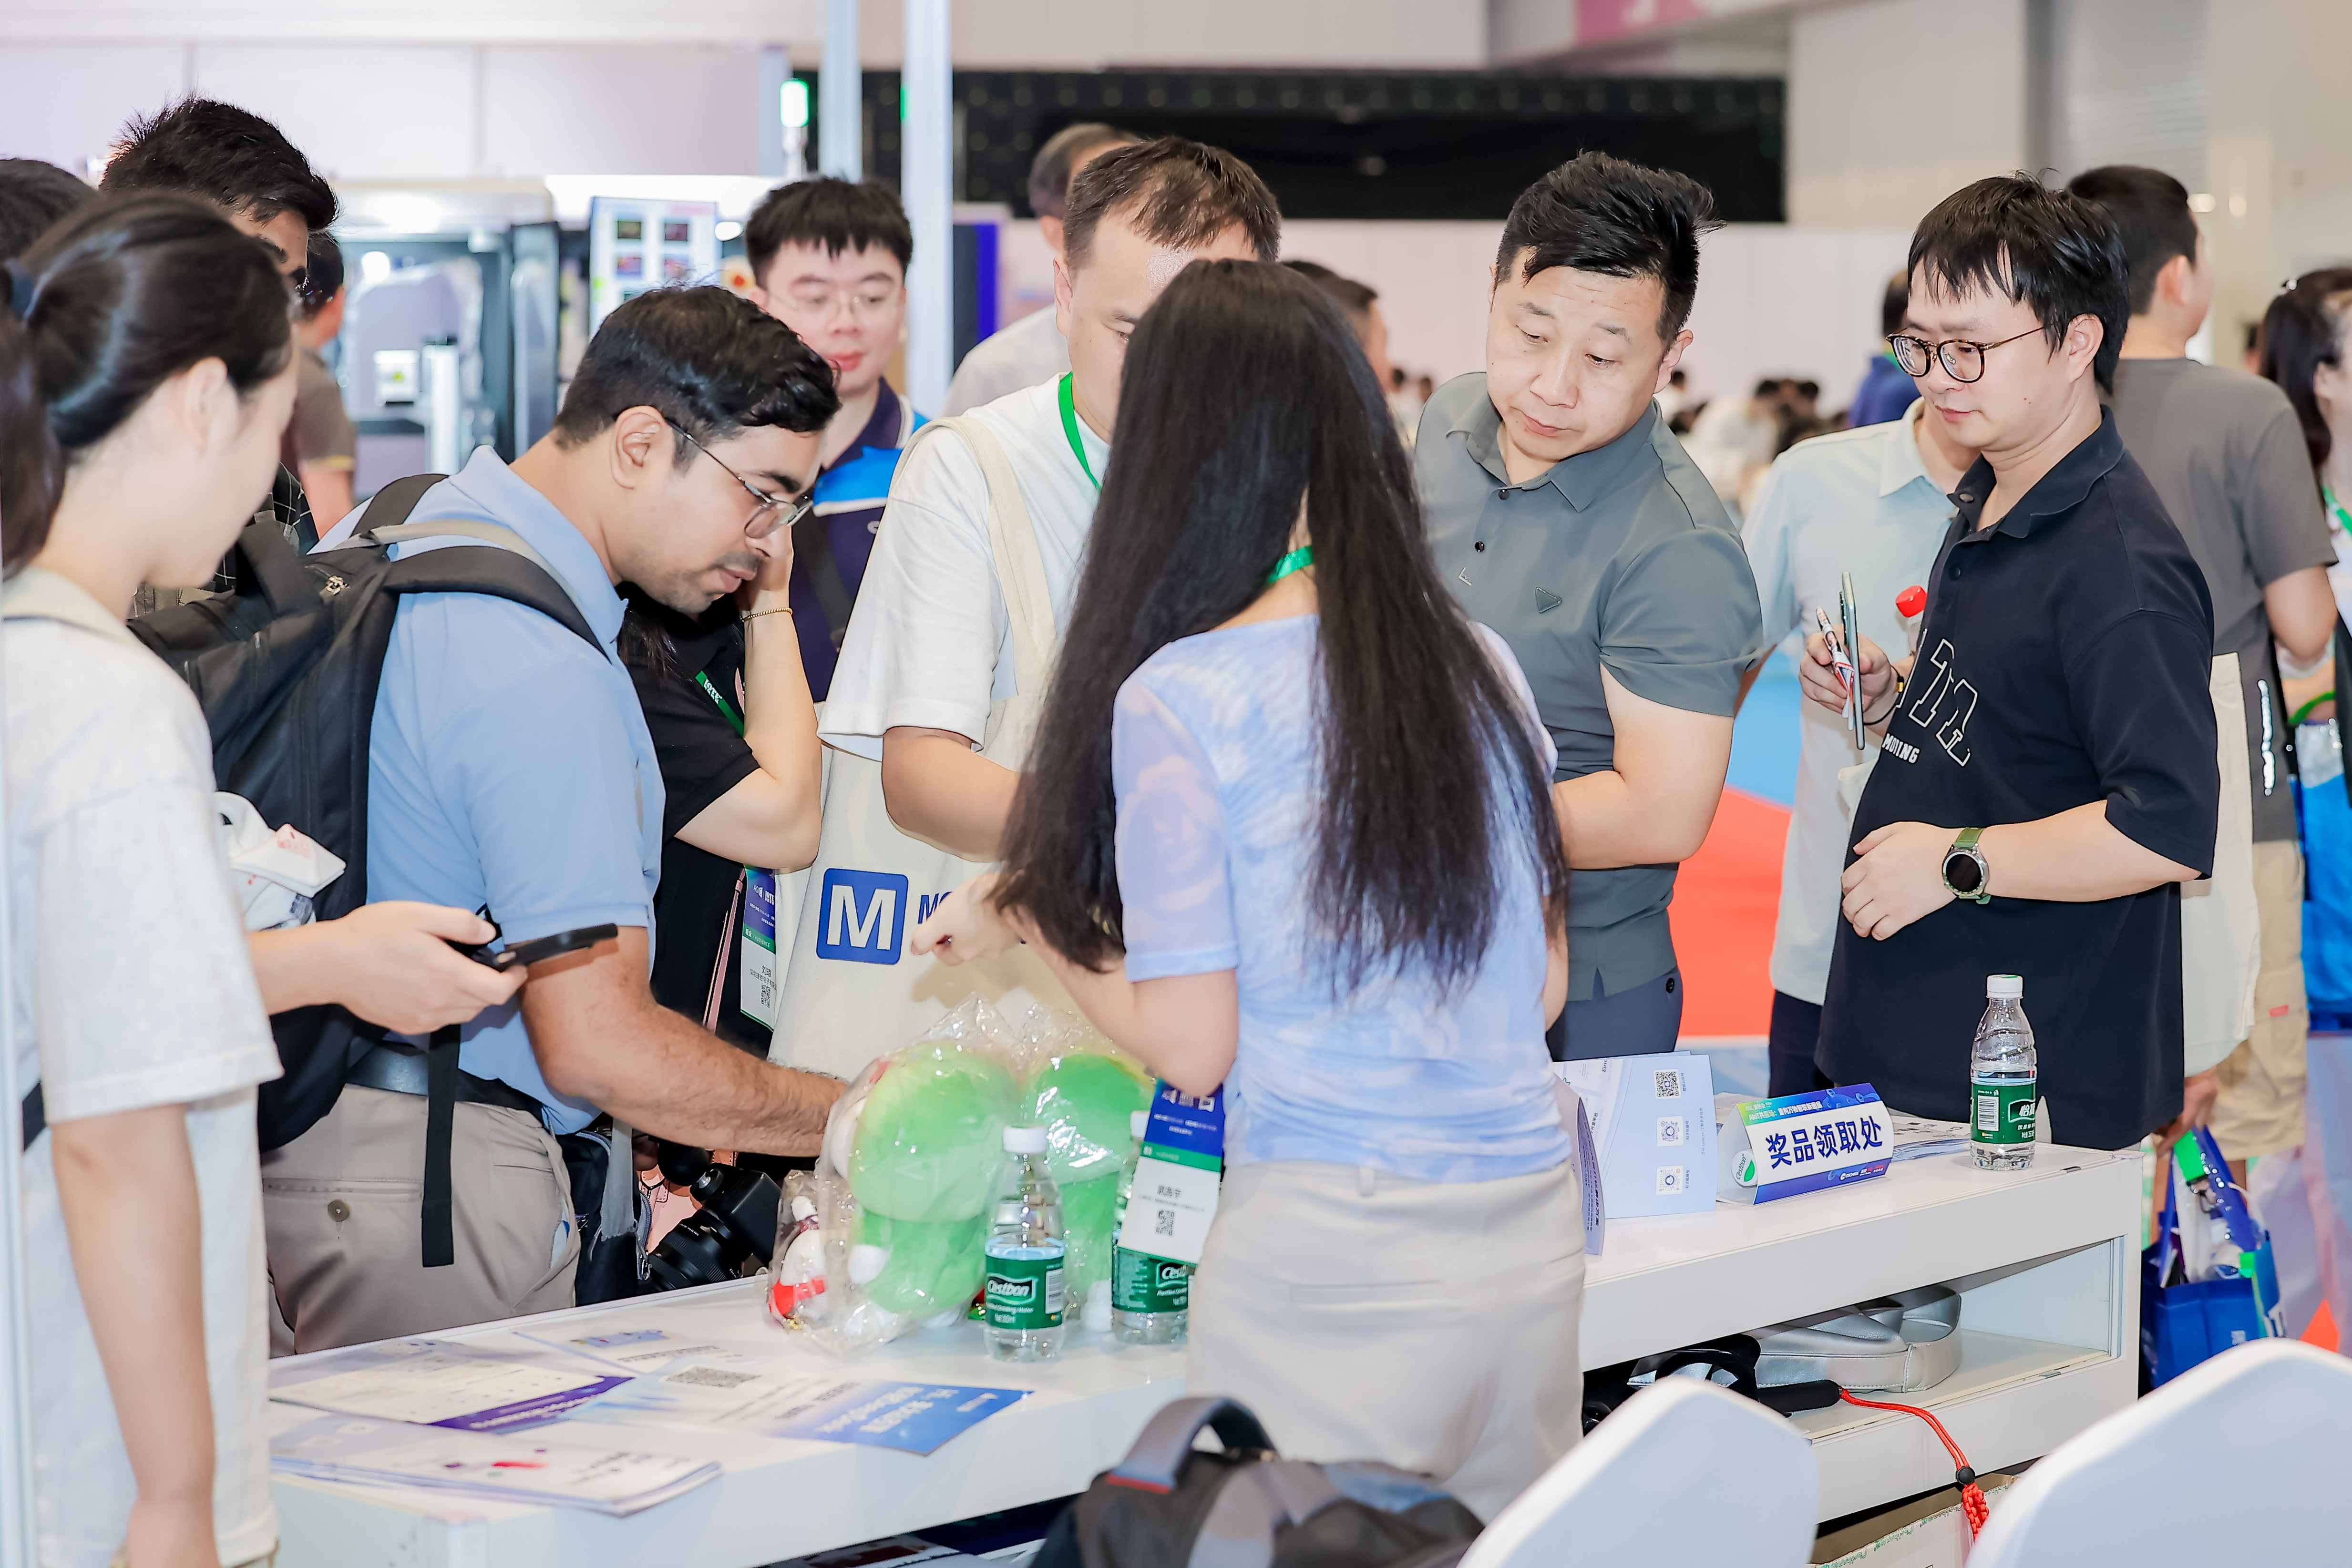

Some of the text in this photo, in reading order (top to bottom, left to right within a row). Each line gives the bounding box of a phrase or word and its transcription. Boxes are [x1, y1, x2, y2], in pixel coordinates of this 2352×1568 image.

[704, 678, 722, 704] IOTE
[826, 884, 897, 950] M
[1765, 1116, 1883, 1169] 奖品领取处
